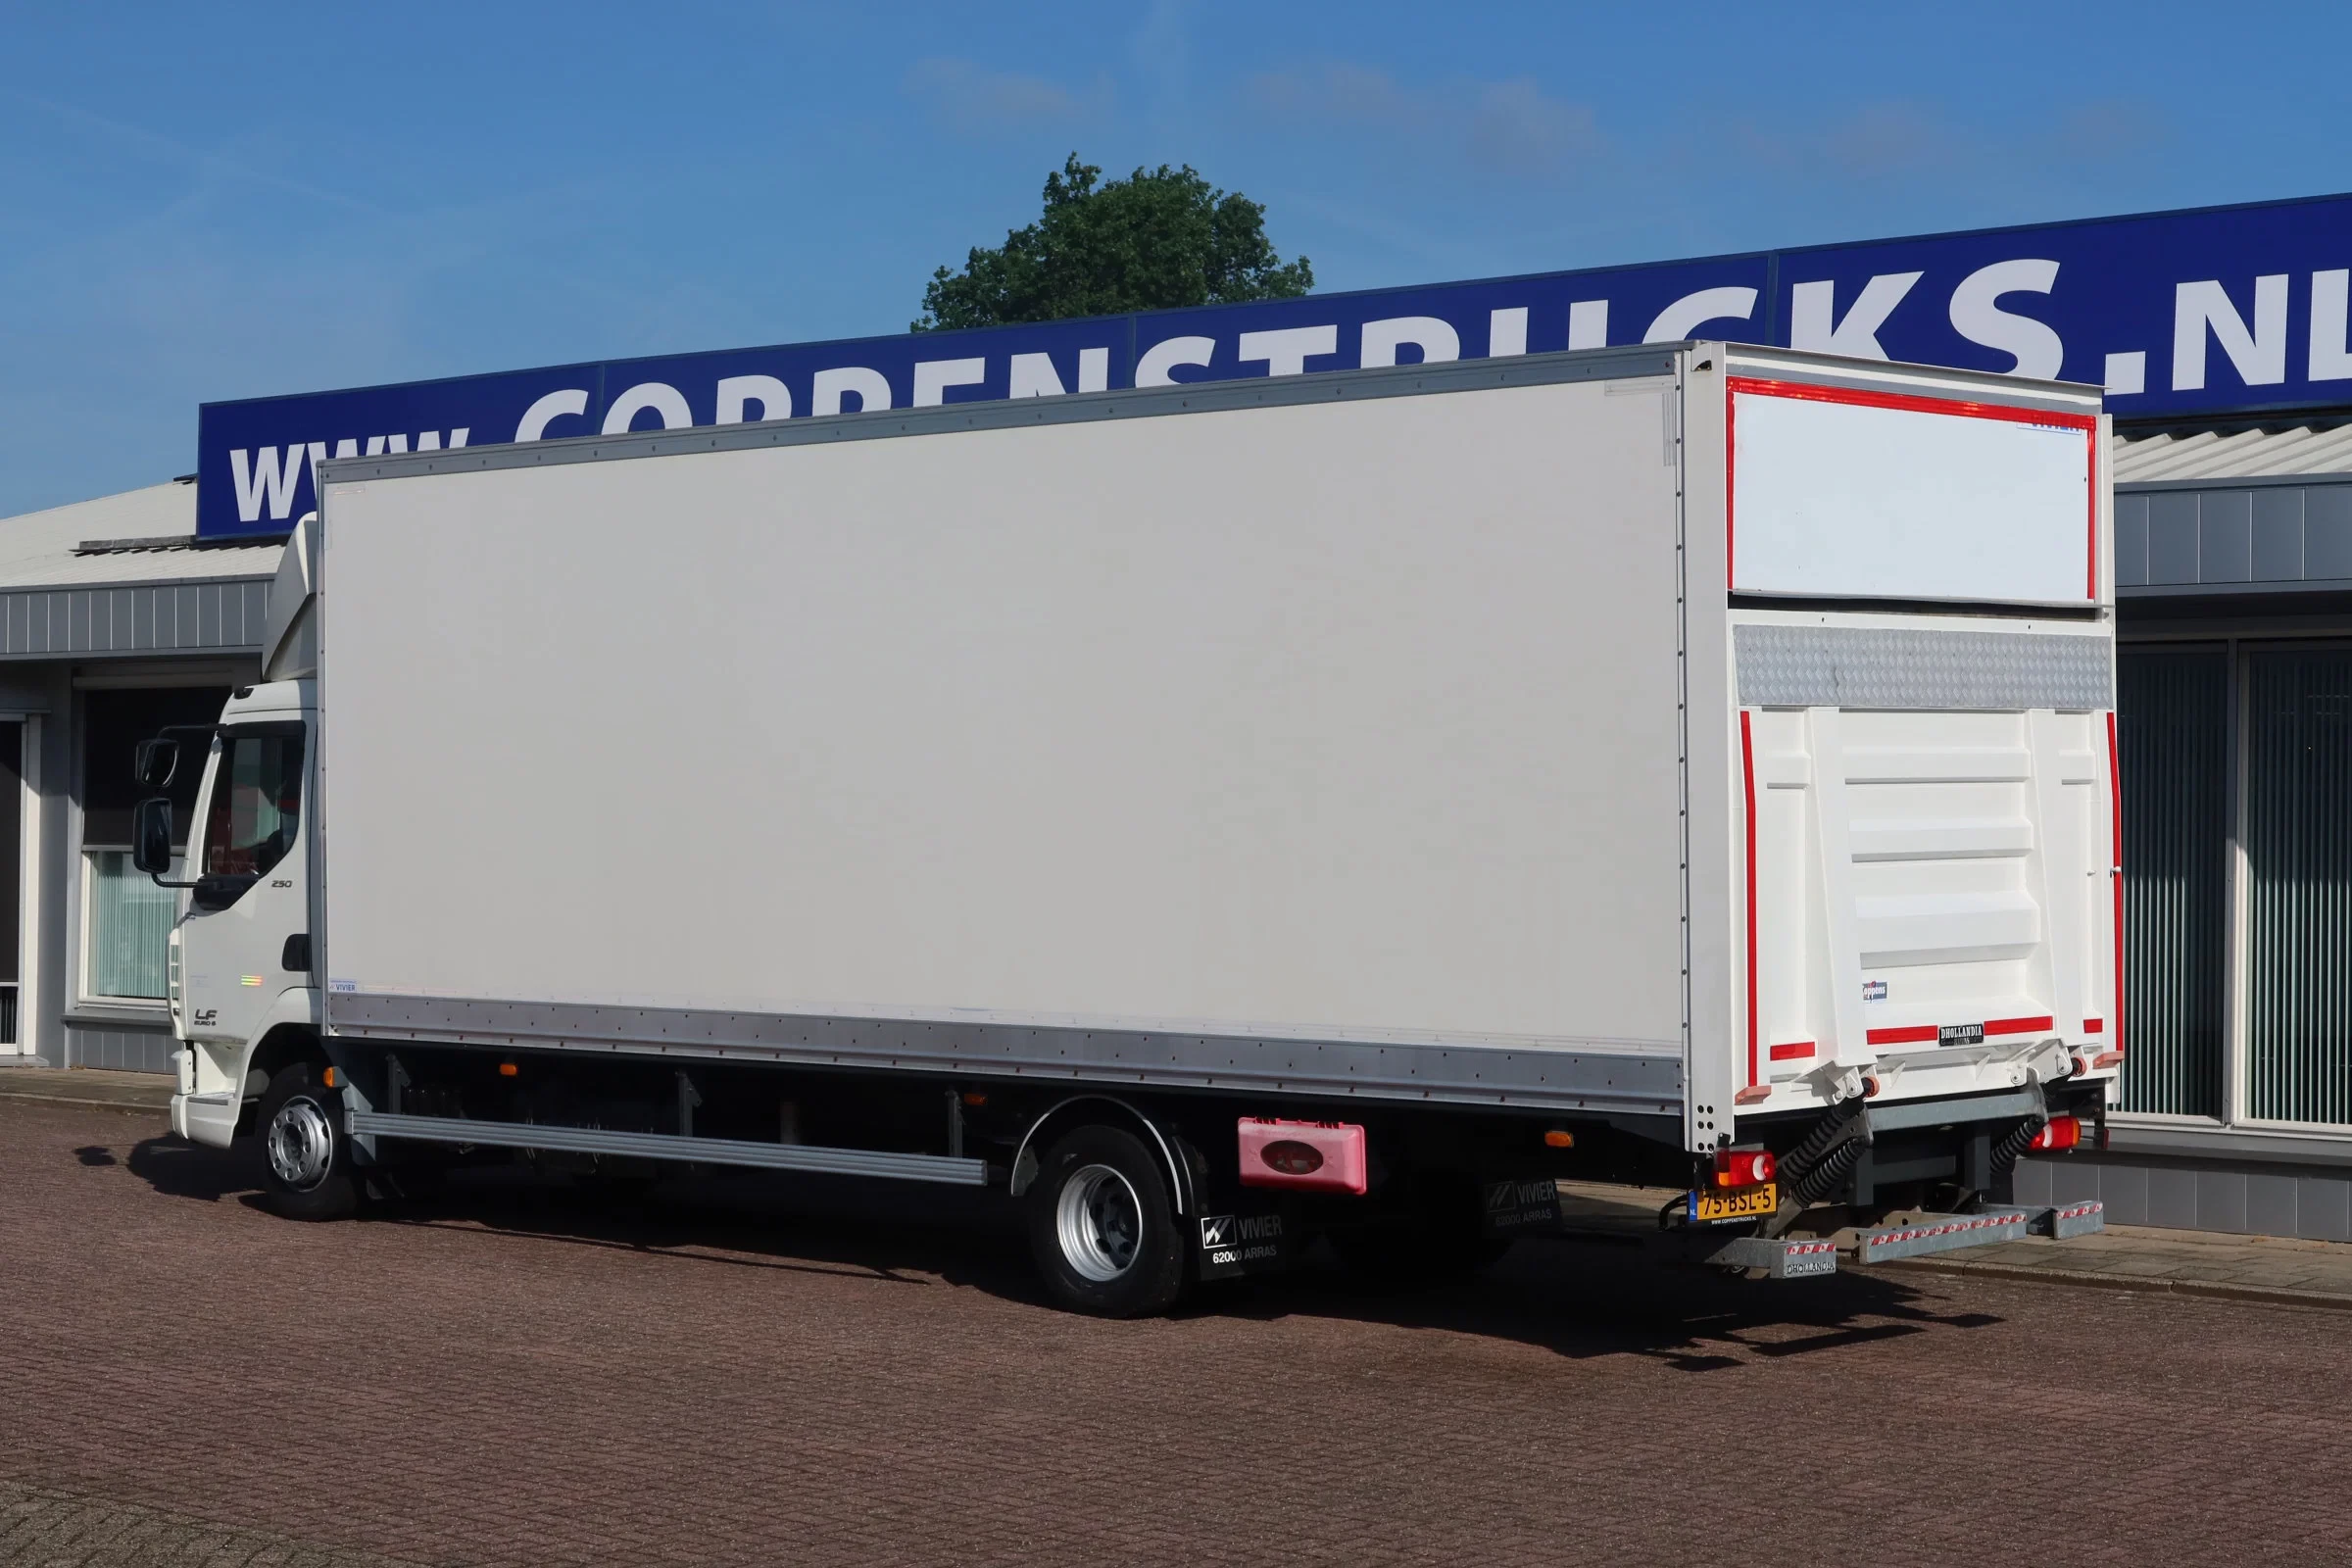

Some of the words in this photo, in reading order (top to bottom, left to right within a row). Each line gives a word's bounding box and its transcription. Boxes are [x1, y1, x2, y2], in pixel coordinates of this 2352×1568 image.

[271, 879, 293, 888] 250
[335, 983, 356, 992] VIVIER
[1862, 986, 1886, 1000] oppens
[194, 1008, 218, 1020] LF
[1940, 1025, 1983, 1039] DHOLLANDIA
[1517, 1180, 1556, 1203] VIVIER
[1703, 1187, 1771, 1216] 75-BSL-5
[1495, 1214, 1521, 1227] 62000
[1523, 1208, 1553, 1223] ARRAS
[1711, 1215, 1757, 1225] WWW.COPPENSTRUCKS.NL
[1239, 1215, 1283, 1240] VIVIER
[1212, 1250, 1243, 1264] 62000
[1244, 1245, 1278, 1260] ARRAS
[1787, 1260, 1836, 1274] DHOLLANDIA
